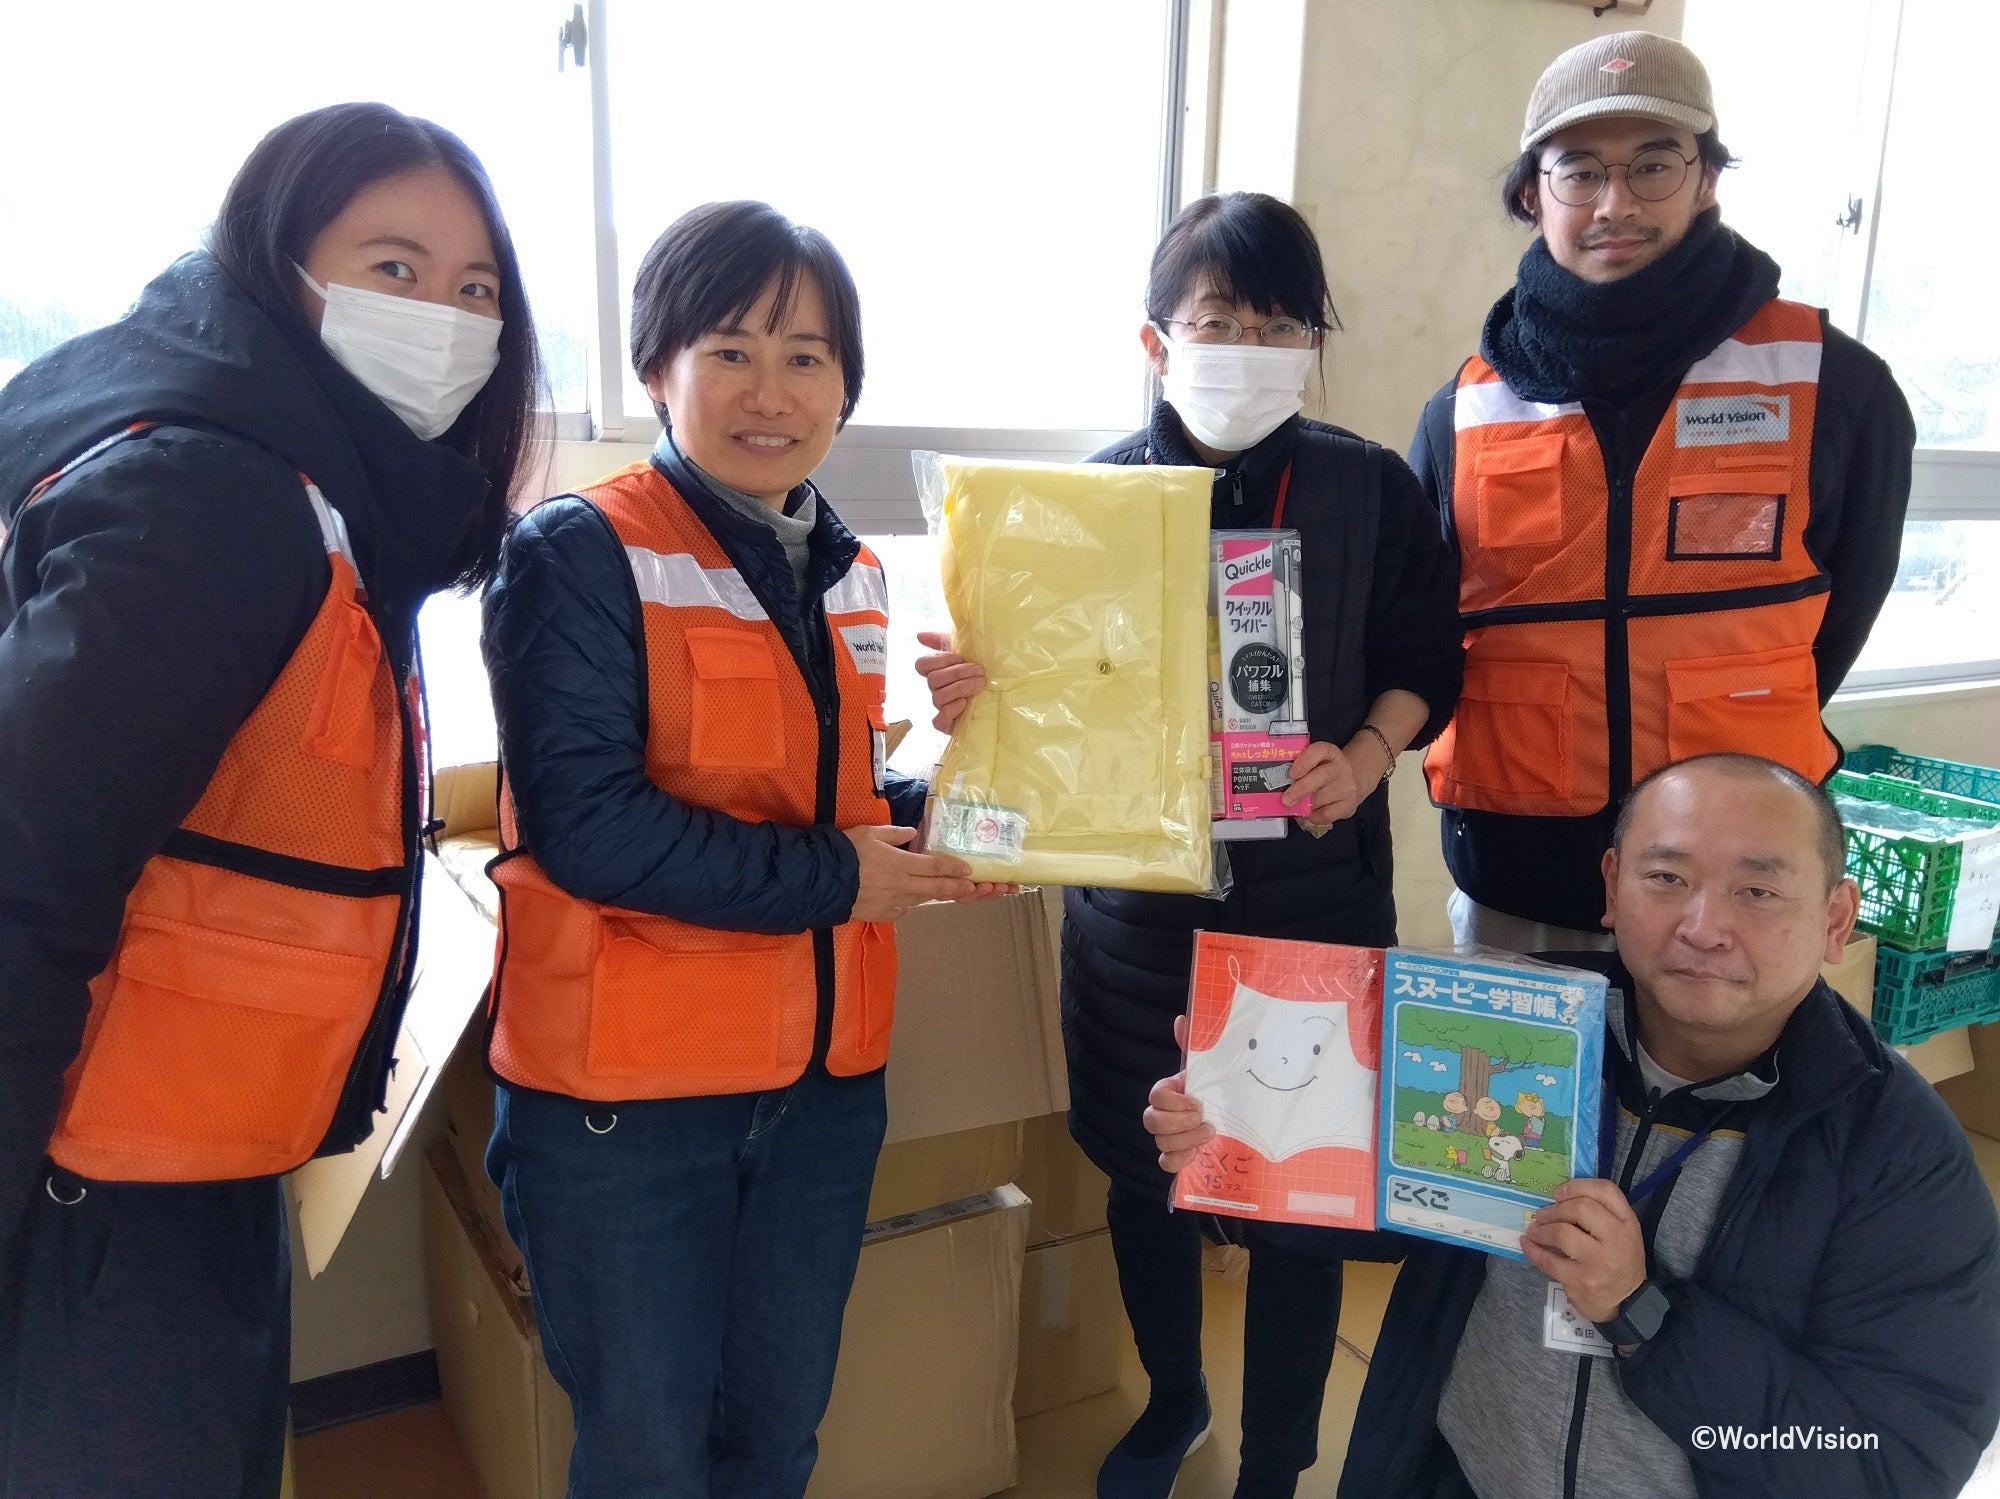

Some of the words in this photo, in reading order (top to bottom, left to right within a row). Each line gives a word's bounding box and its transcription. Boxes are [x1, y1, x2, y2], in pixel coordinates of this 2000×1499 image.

[1685, 412, 1724, 426] World
[1727, 411, 1766, 423] Vision
[1225, 554, 1272, 580] Quickle
[1226, 600, 1273, 616] クイックル
[1231, 618, 1268, 633] ワイパー
[1236, 664, 1284, 678] パワフル
[1248, 679, 1272, 692] 捕集
[1233, 775, 1258, 783] POWER
[1233, 783, 1250, 791] ヘッド
[1394, 973, 1557, 1019] スヌーピー学習帳
[1200, 1150, 1254, 1175] こくご
[1393, 1182, 1450, 1211] こくご
